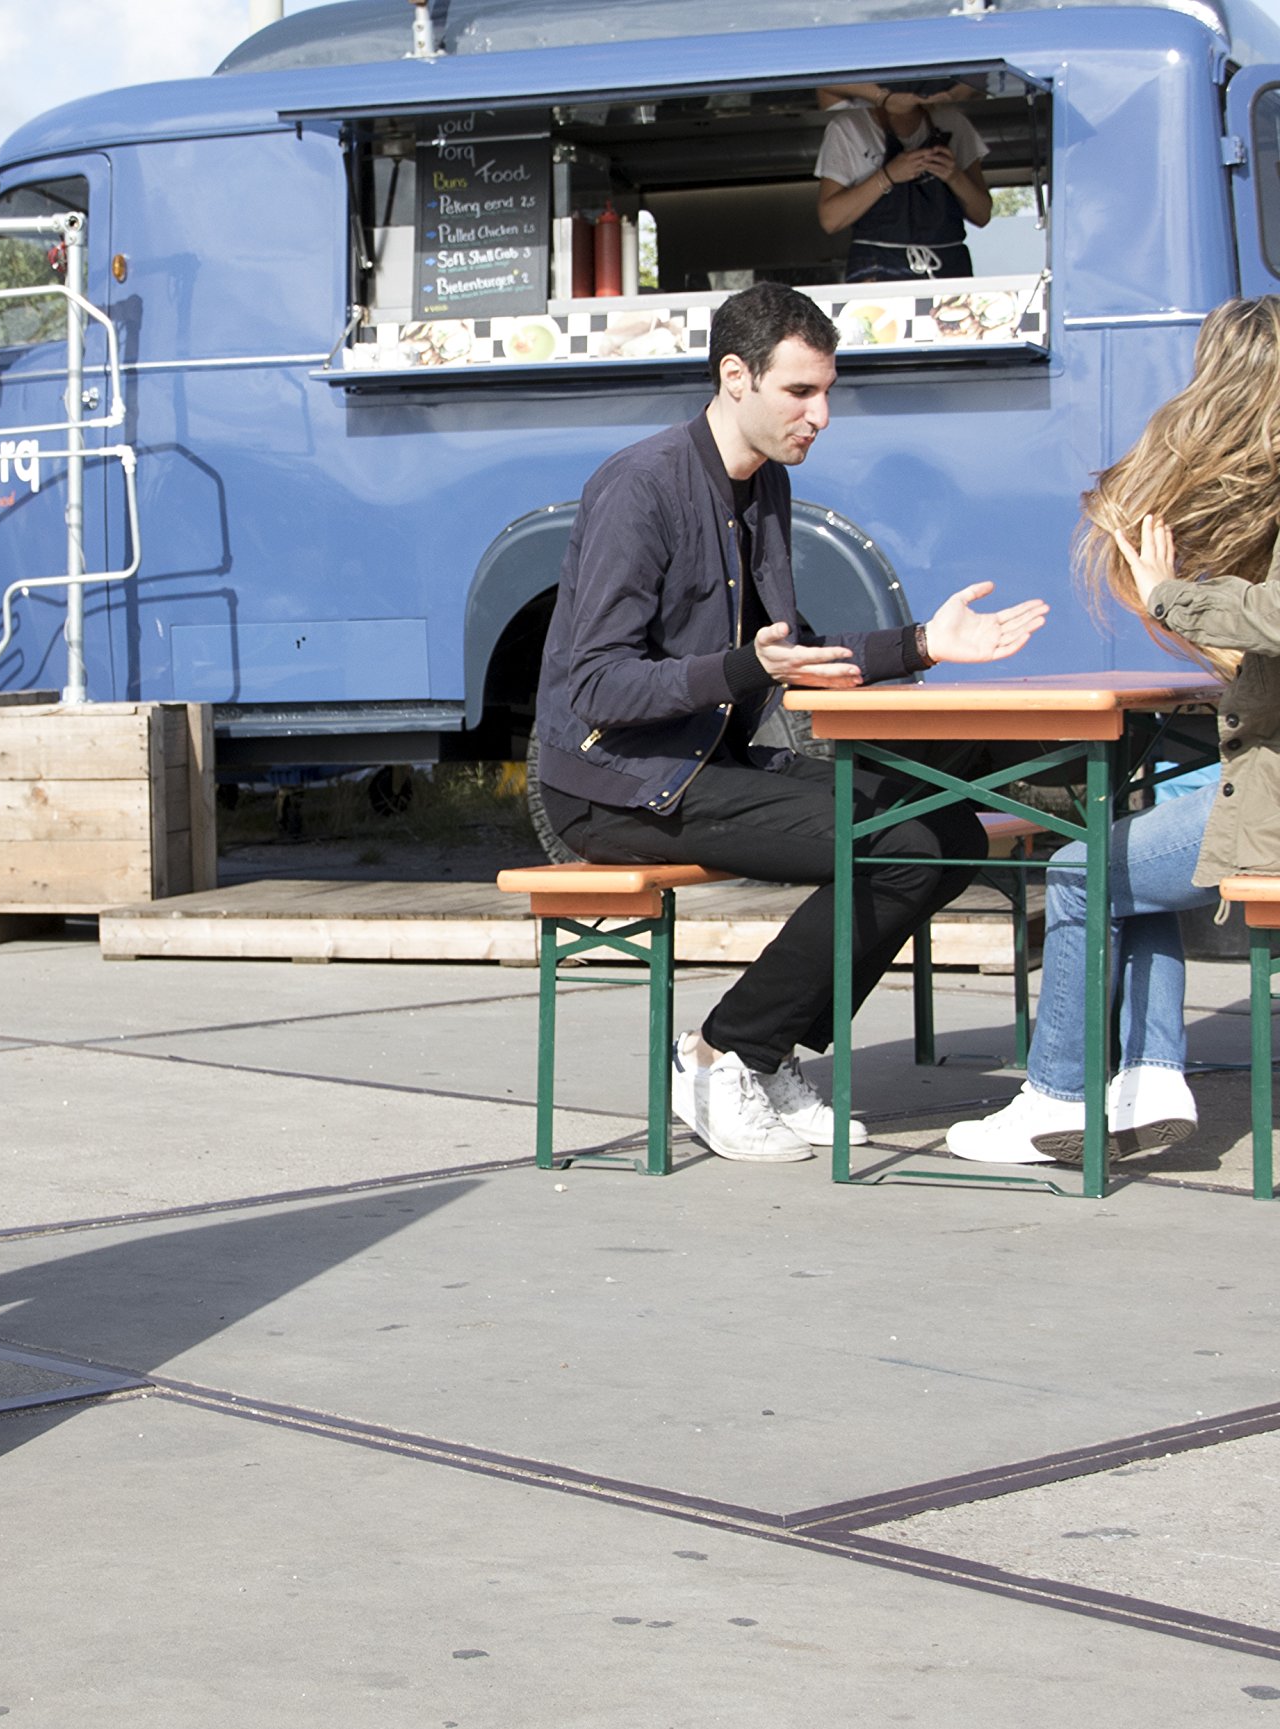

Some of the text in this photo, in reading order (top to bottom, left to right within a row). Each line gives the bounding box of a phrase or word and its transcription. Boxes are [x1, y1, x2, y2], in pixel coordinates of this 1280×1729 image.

[432, 171, 468, 191] Buns
[474, 159, 531, 183] Food
[439, 195, 480, 218] Peking
[438, 223, 475, 243] Pulled
[477, 225, 519, 240] Chicken
